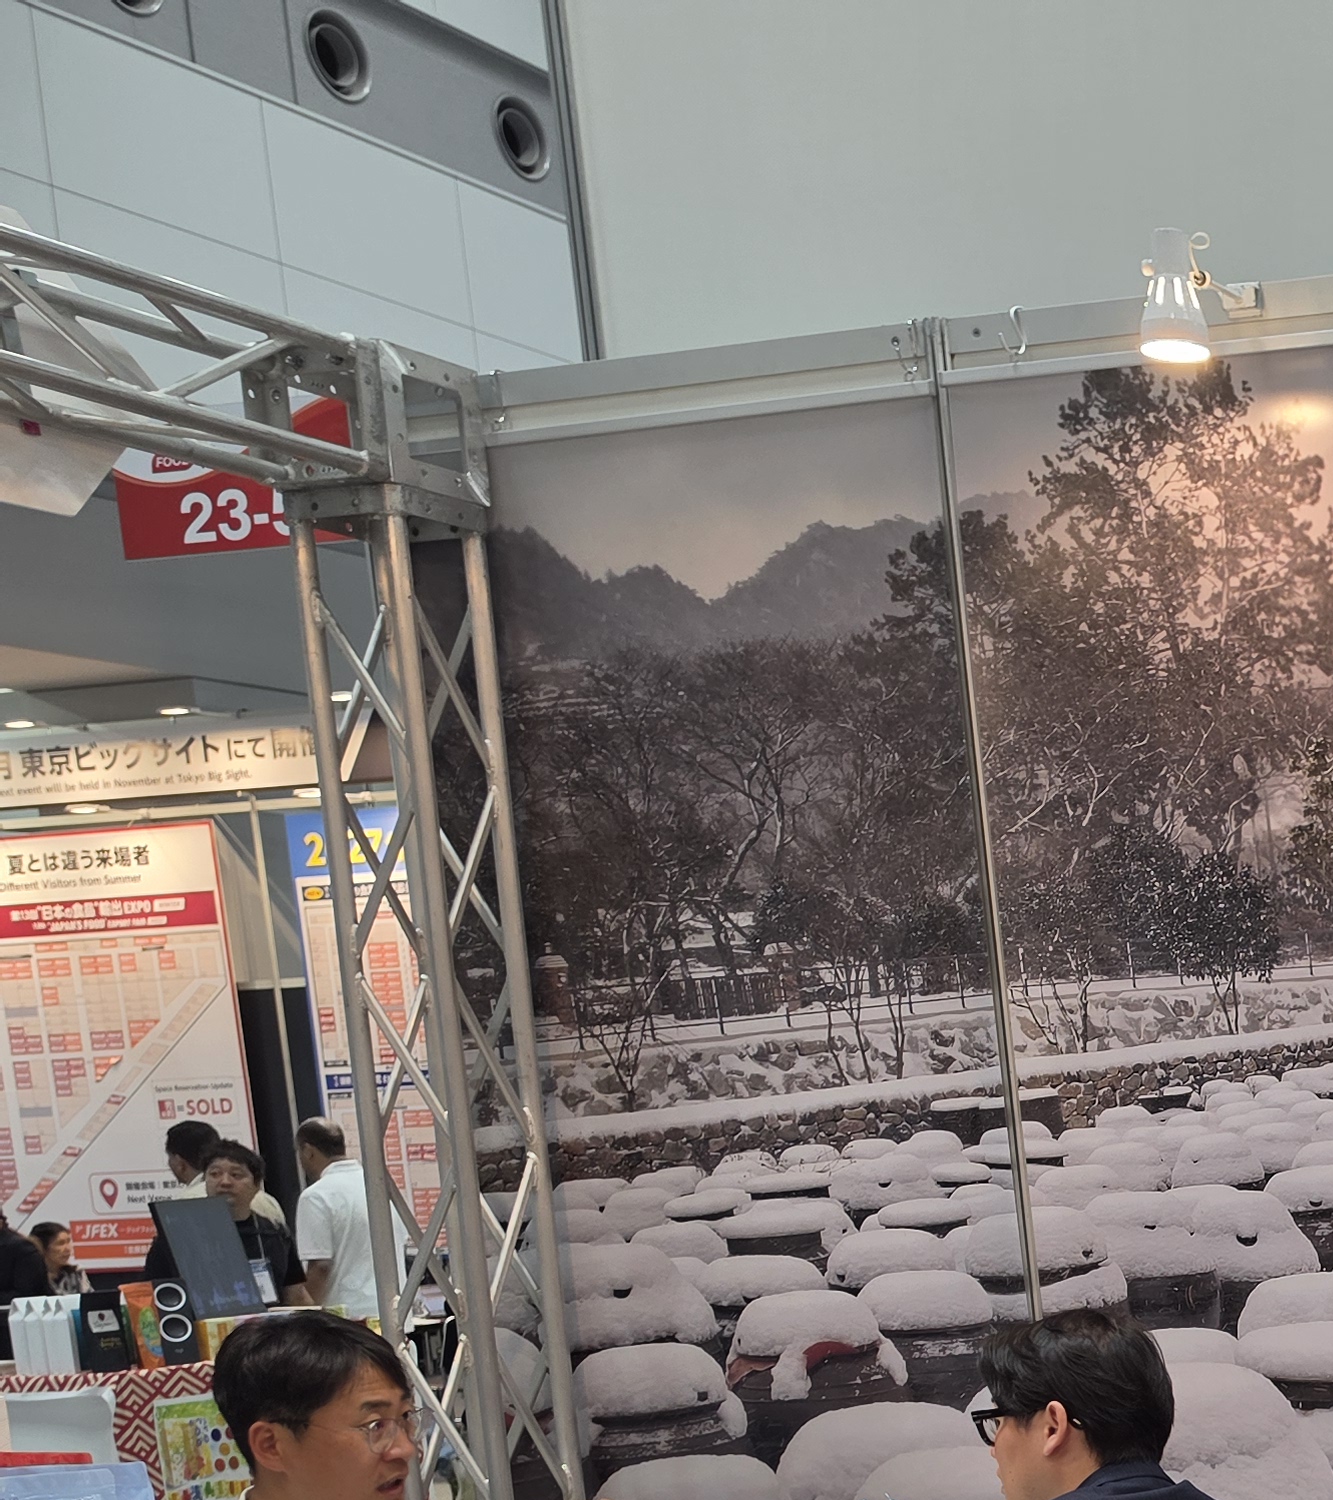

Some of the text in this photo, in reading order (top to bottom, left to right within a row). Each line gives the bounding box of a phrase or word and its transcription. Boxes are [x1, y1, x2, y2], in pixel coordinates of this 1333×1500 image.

[7, 845, 150, 875] 夏とは違う来場者
[186, 1098, 233, 1116] SOLD
